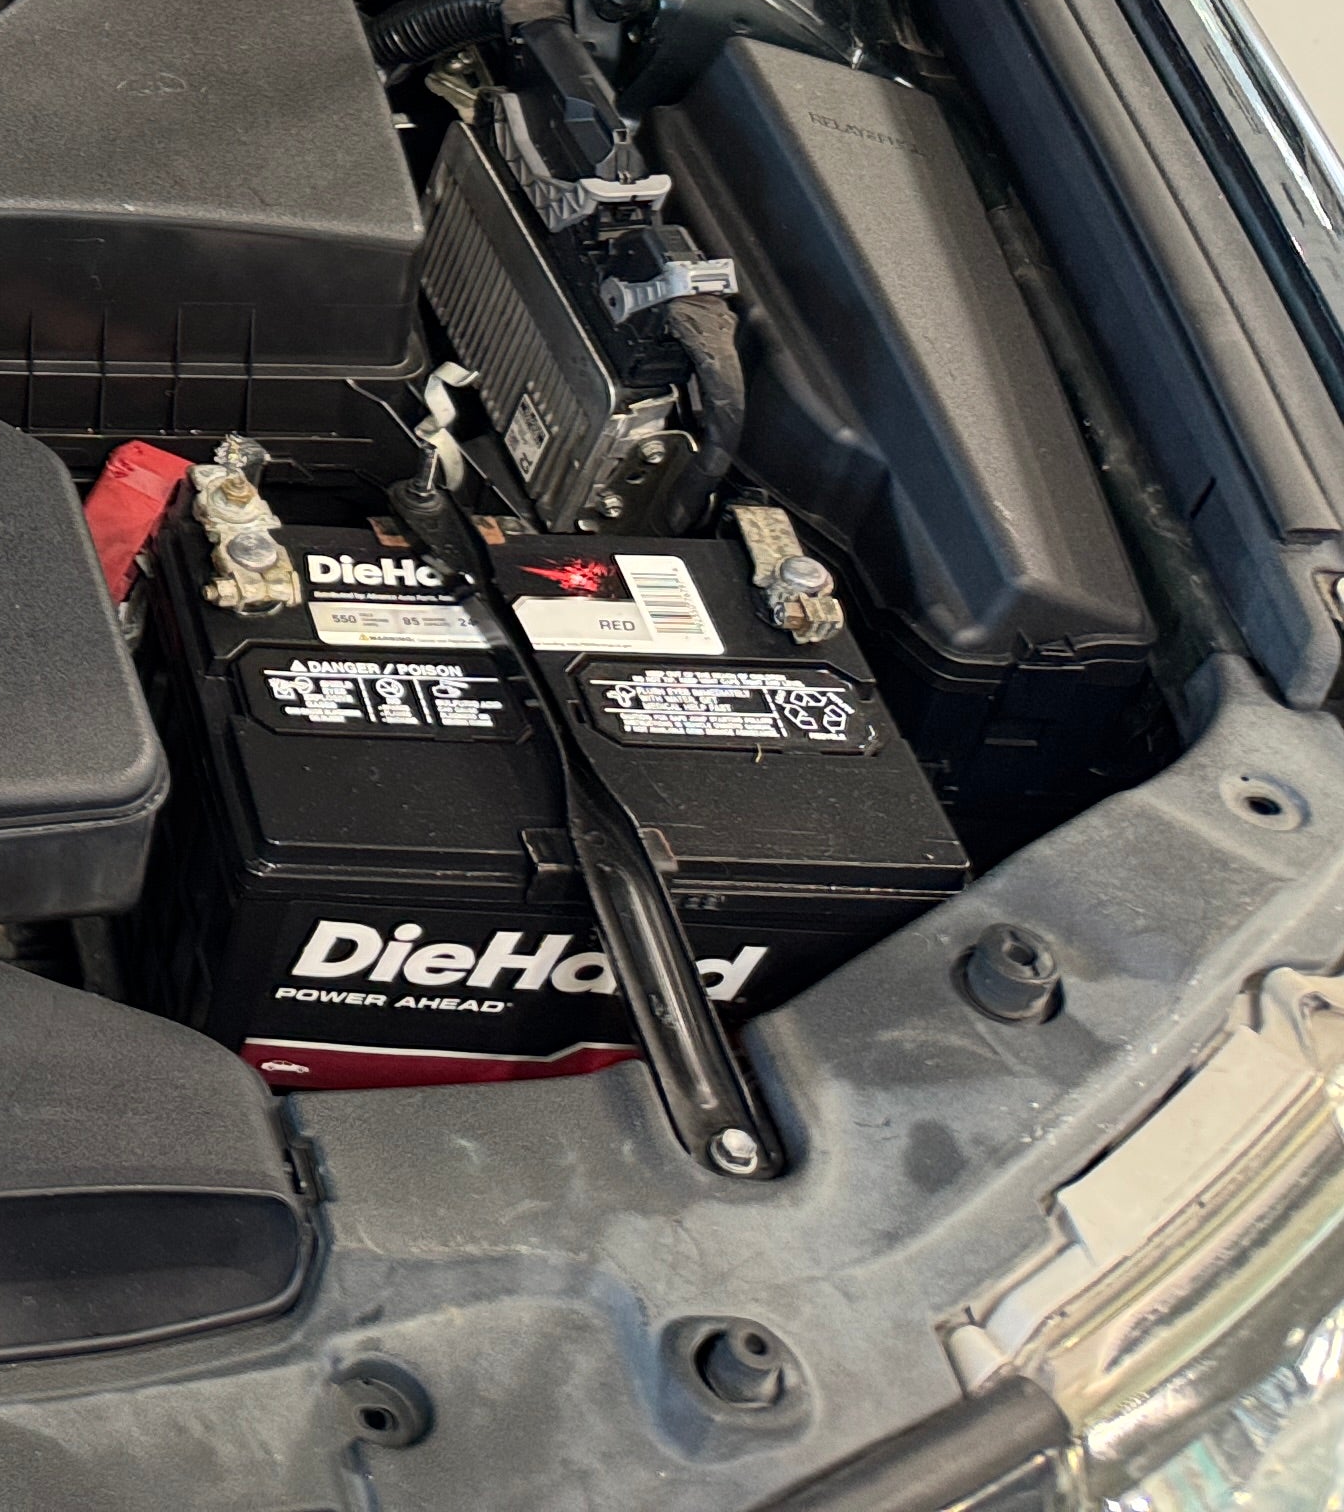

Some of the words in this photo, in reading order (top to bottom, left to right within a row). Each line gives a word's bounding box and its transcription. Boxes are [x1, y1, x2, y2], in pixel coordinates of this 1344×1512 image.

[331, 614, 357, 624] 550
[599, 619, 636, 632] RED
[307, 660, 381, 675] DANGER
[398, 663, 463, 677] POISON
[291, 919, 769, 1003] DieHad
[275, 987, 387, 1008] POWER
[394, 994, 507, 1014] AHEAD
